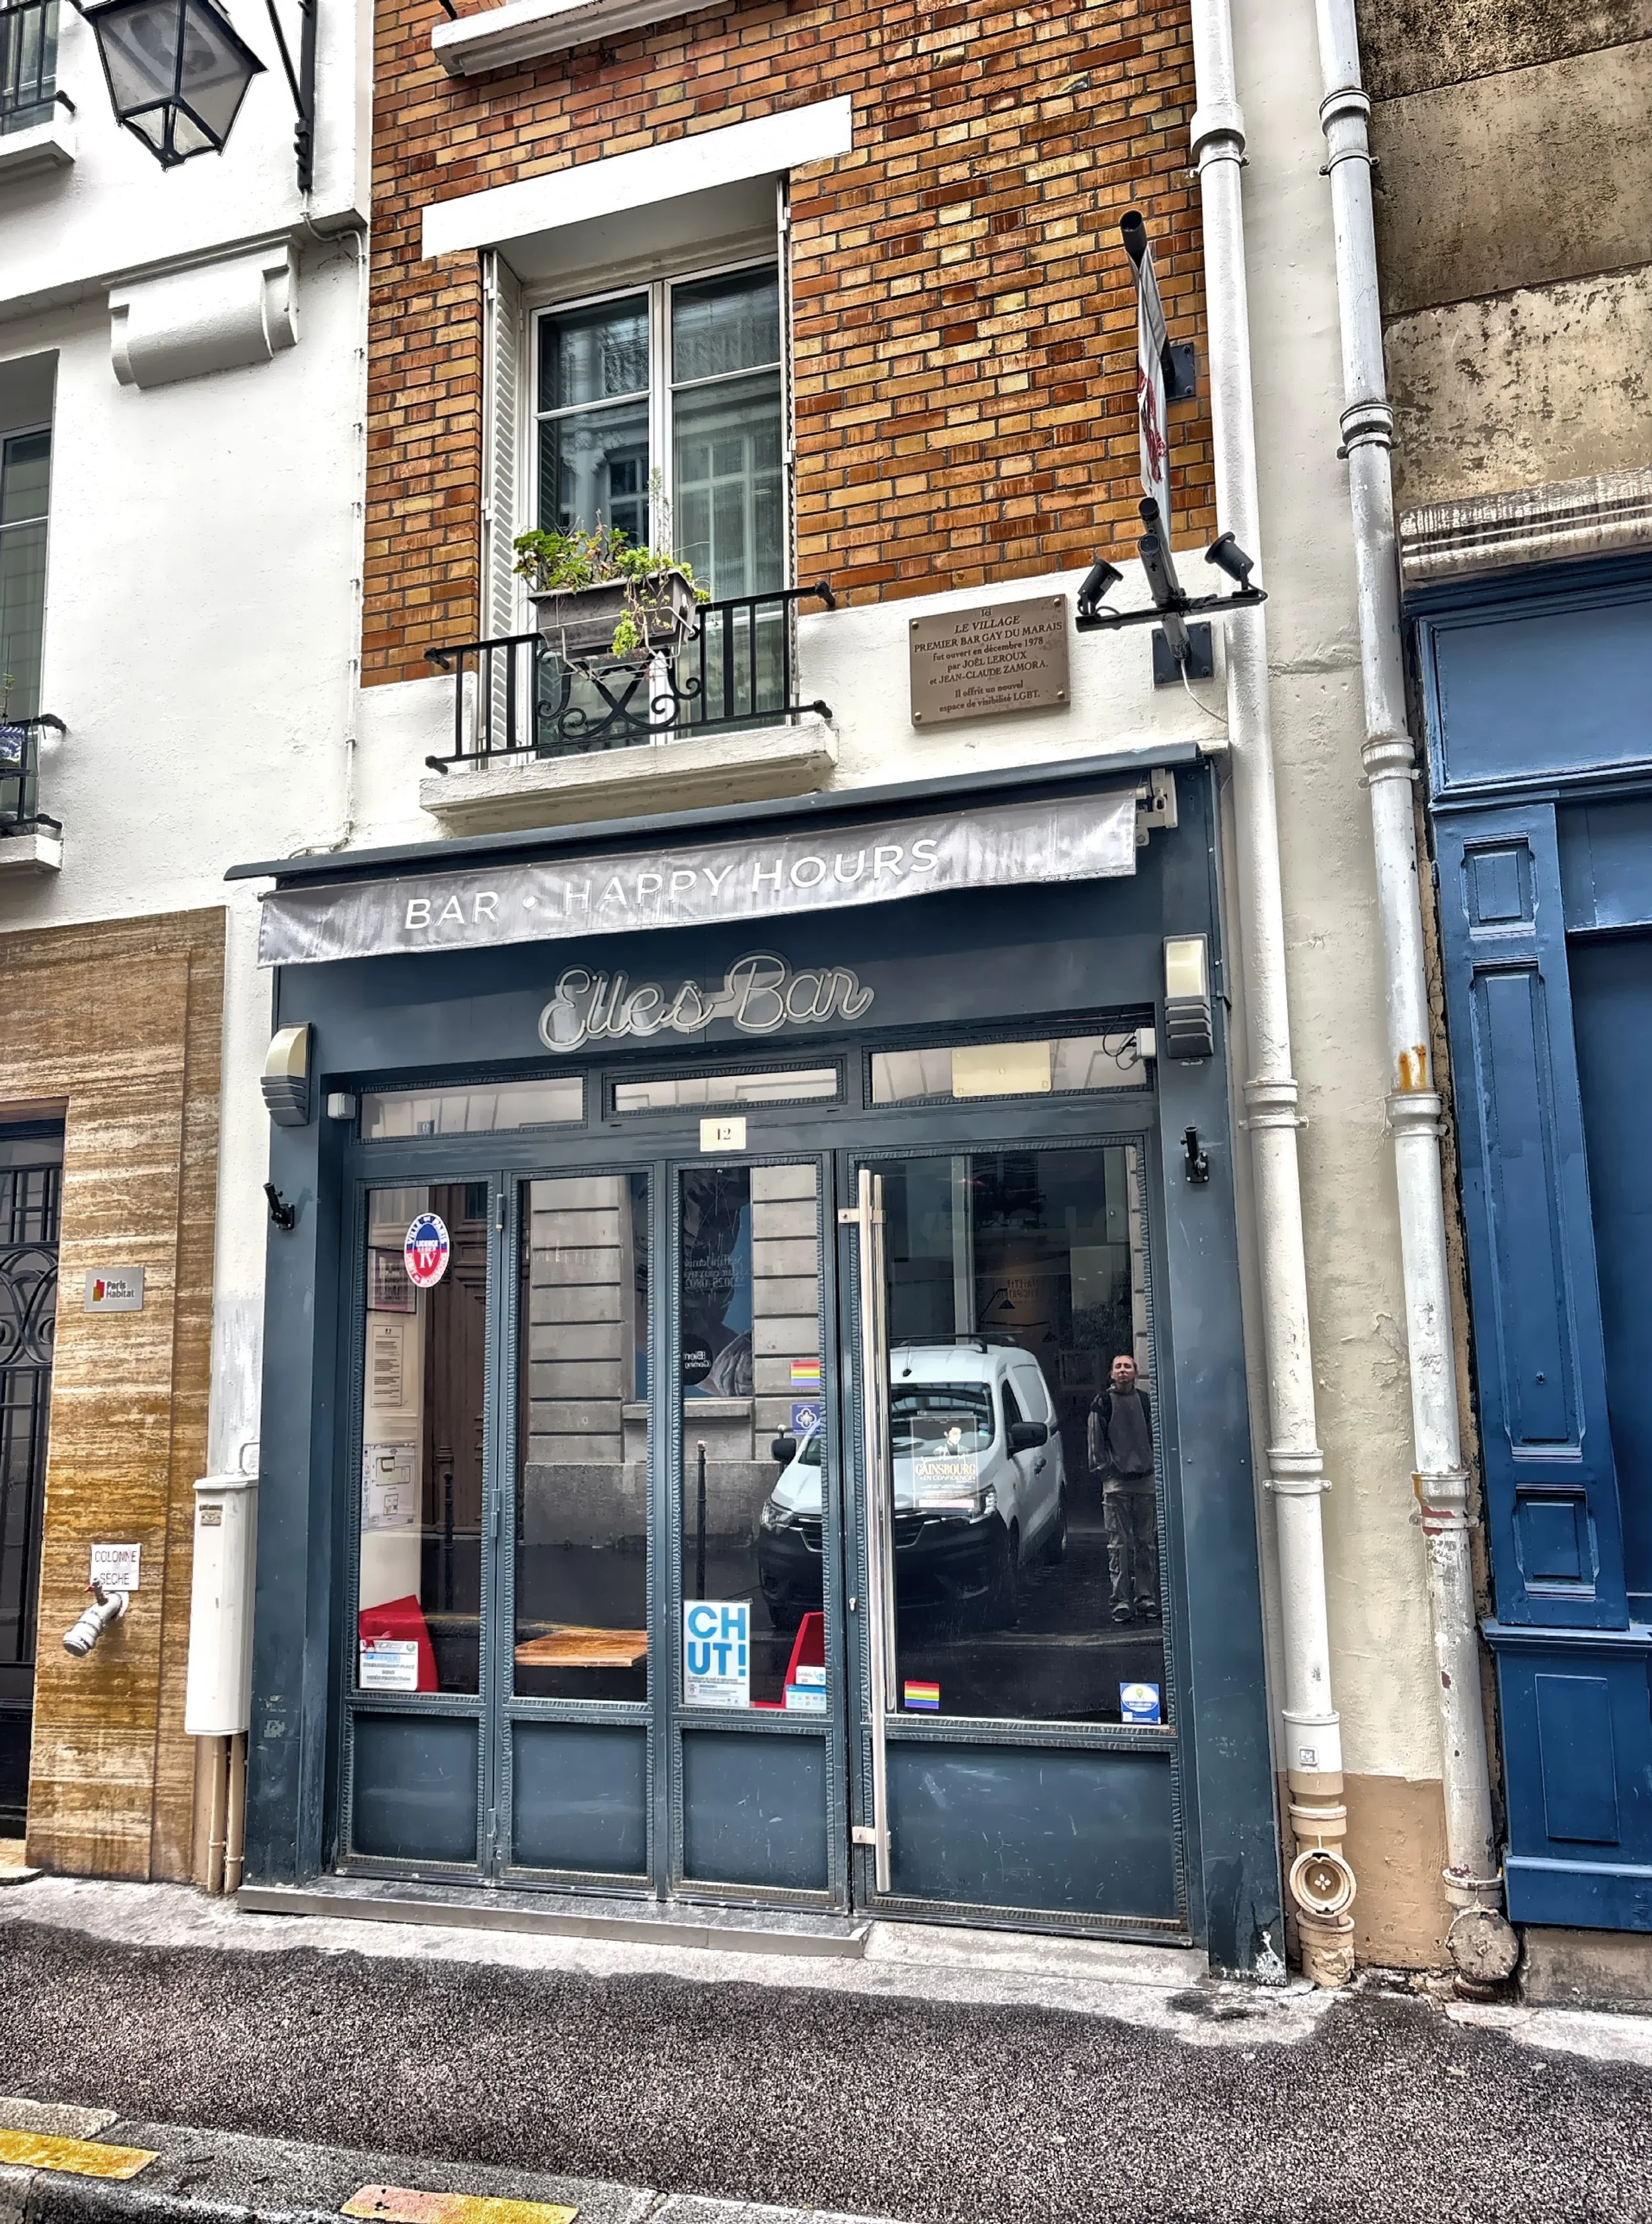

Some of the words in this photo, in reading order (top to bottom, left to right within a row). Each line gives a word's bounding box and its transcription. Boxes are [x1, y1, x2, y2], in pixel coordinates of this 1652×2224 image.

[981, 609, 991, 617] Ici
[954, 623, 969, 634] LE
[971, 615, 1021, 631] VILLAGE
[914, 639, 958, 653] PREMIER
[960, 634, 981, 646] BAR
[981, 630, 1002, 642] GAY
[1004, 627, 1020, 638] DU
[1022, 621, 1063, 636] MARAIS
[932, 652, 945, 661] fut
[946, 648, 971, 659] ouvert
[973, 647, 983, 655] en
[985, 641, 1022, 654] décembre
[1024, 637, 1043, 648] 1978
[938, 667, 1002, 685] JEAN-CLAUDE
[1002, 659, 1049, 675] ZAMORA.
[947, 663, 961, 673] par
[987, 651, 1028, 665] LEROUX
[954, 689, 961, 698] Il
[962, 686, 984, 698] offrit
[997, 679, 1024, 692] nouvel
[938, 702, 965, 714] espace
[966, 698, 977, 709] de
[977, 692, 1012, 707] visibilité
[1012, 689, 1041, 702] LGBT.
[404, 889, 500, 930] BAR
[562, 864, 734, 916] HAPPY
[750, 838, 939, 895] HOURS
[541, 969, 715, 1047] Elles
[727, 955, 868, 1029] Bar
[715, 1127, 732, 1141] 12
[419, 1253, 437, 1269] IV
[106, 1280, 126, 1289] Paris
[106, 1288, 135, 1298] Habitat
[915, 1464, 976, 1475] GAINSBOURG
[94, 1551, 137, 1563] COLONNE
[688, 1606, 746, 1641] CH
[688, 1641, 746, 1677] UT!
